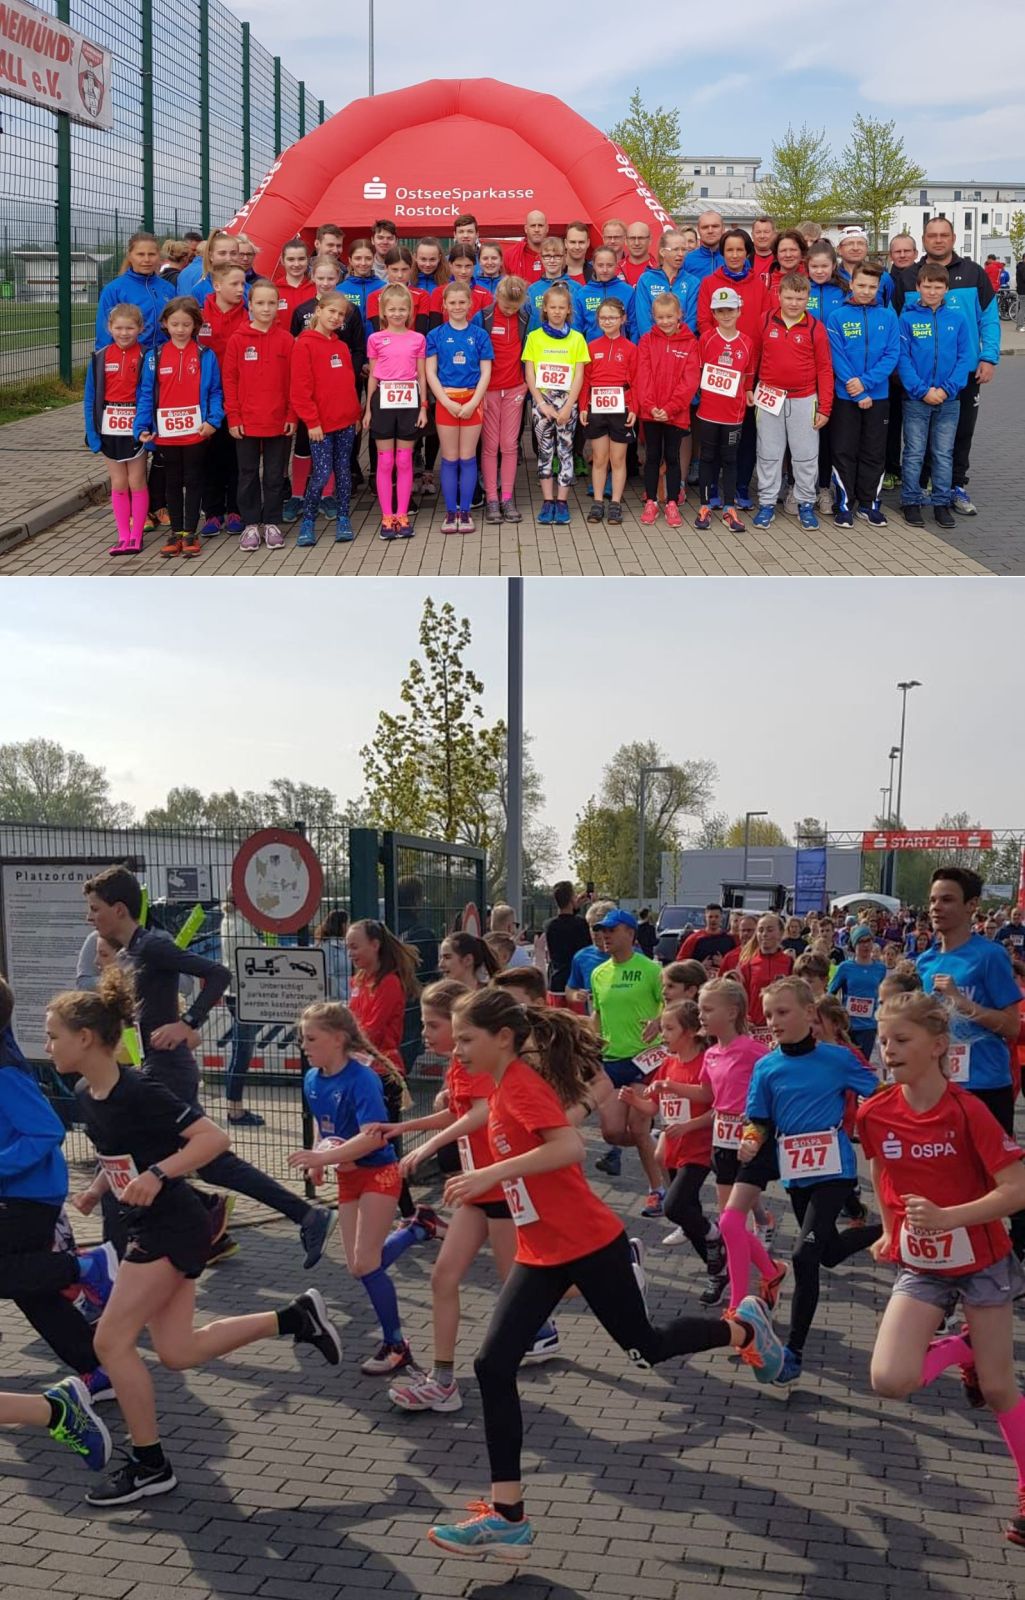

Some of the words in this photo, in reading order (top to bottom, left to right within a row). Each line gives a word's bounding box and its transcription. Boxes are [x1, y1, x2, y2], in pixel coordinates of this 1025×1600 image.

[31, 68, 62, 100] e.V.
[395, 187, 534, 201] OstseeSparkasse
[395, 204, 460, 216] Rostock
[719, 292, 728, 300] D
[542, 371, 566, 384] 682
[707, 374, 732, 390] 680
[387, 390, 412, 403] 674
[595, 395, 618, 408] 660
[757, 389, 777, 408] 725
[164, 416, 195, 431] 658
[890, 837, 930, 848] START
[935, 836, 963, 847] ZIEL
[15, 871, 99, 881] Platzordnu
[622, 970, 642, 981] MR
[642, 1050, 667, 1067] 728
[717, 1121, 744, 1140] 674
[911, 1142, 957, 1158] OSPA
[788, 1146, 828, 1169] 747
[906, 1232, 953, 1260] 667
